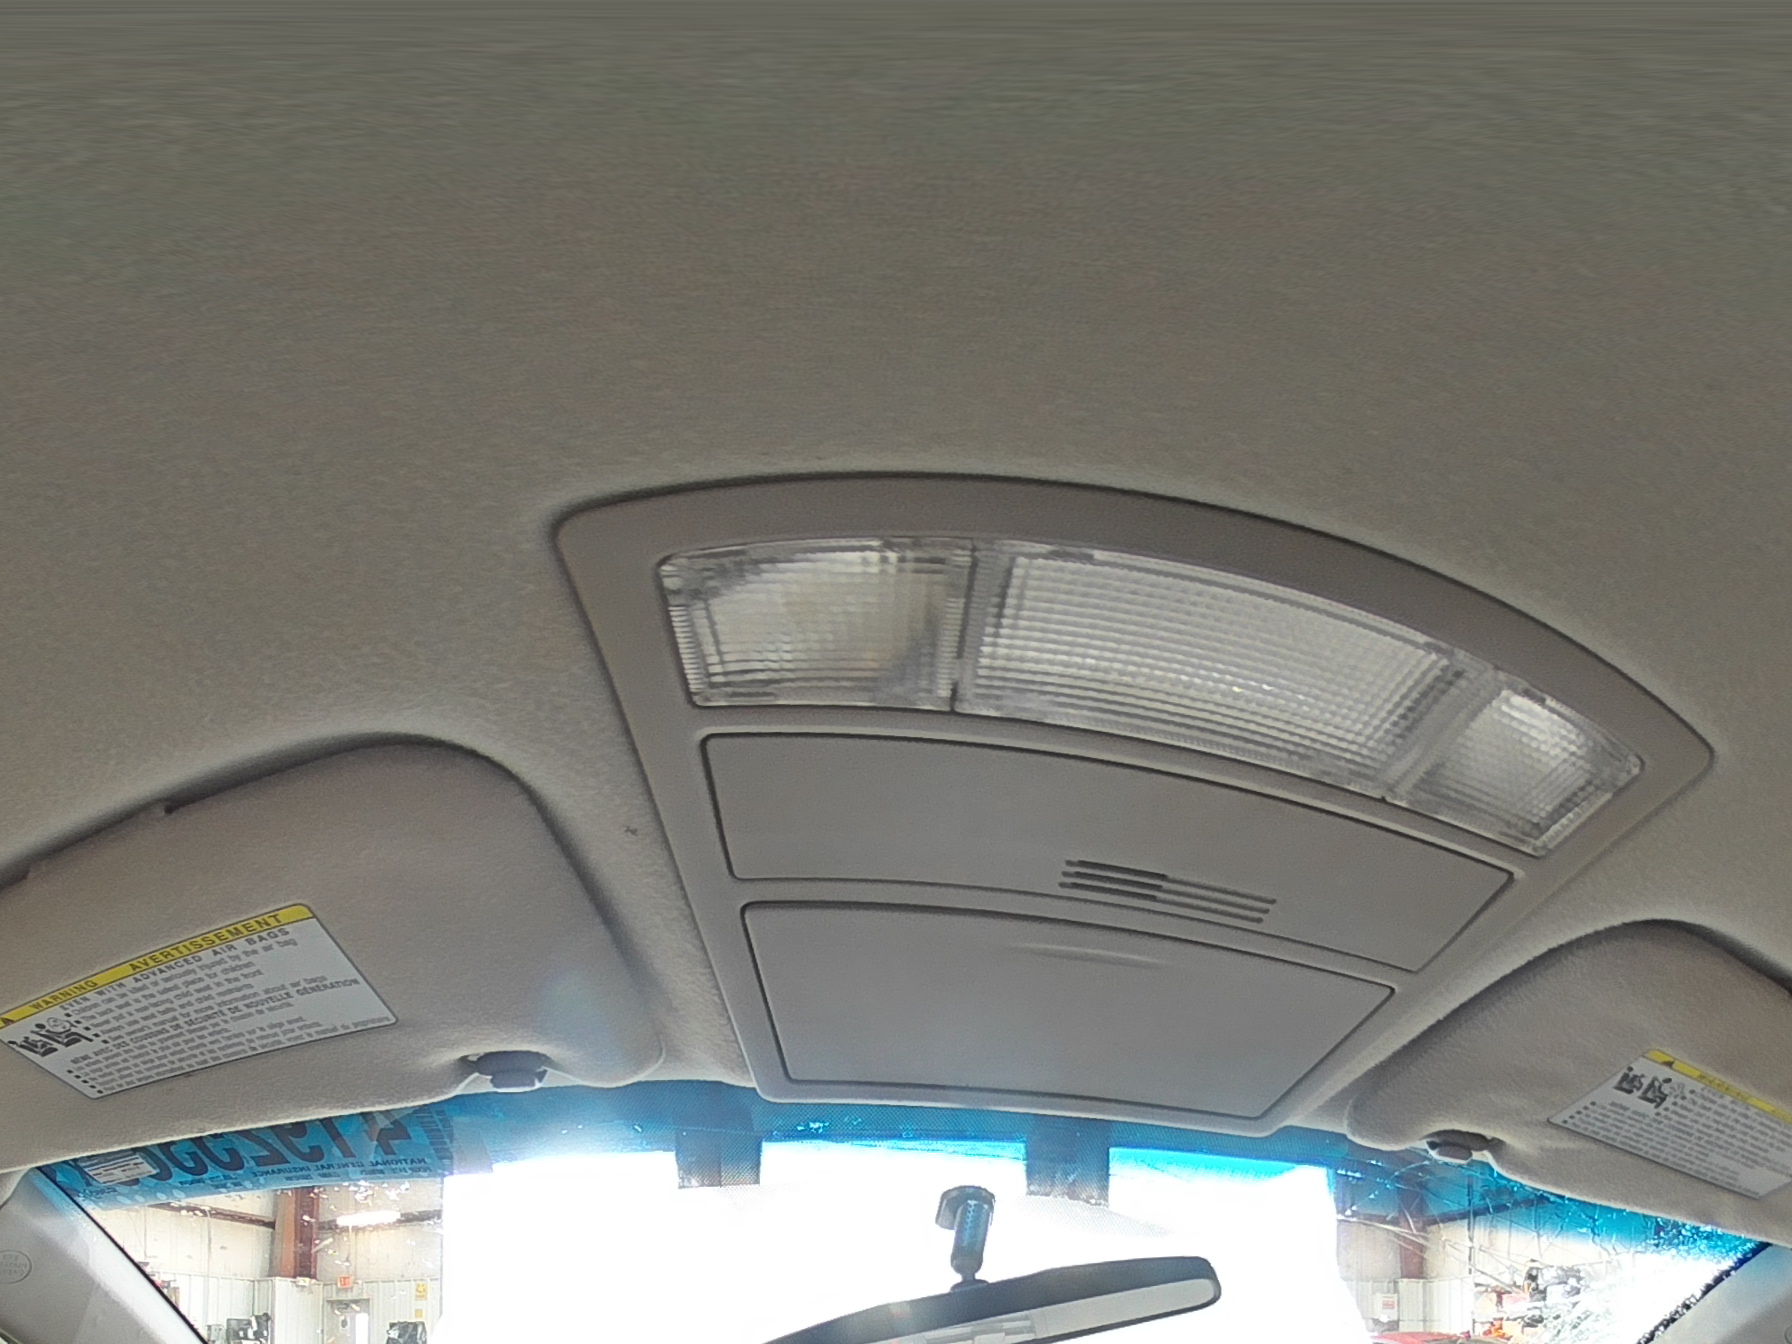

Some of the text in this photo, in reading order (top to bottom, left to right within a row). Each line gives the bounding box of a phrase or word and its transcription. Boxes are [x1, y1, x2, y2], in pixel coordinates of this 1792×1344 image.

[29, 913, 282, 1010] WARNING AVERTISSEMENT
[133, 955, 202, 983] ADVANCED
[211, 944, 237, 957] AIR
[245, 928, 289, 945] BAGS
